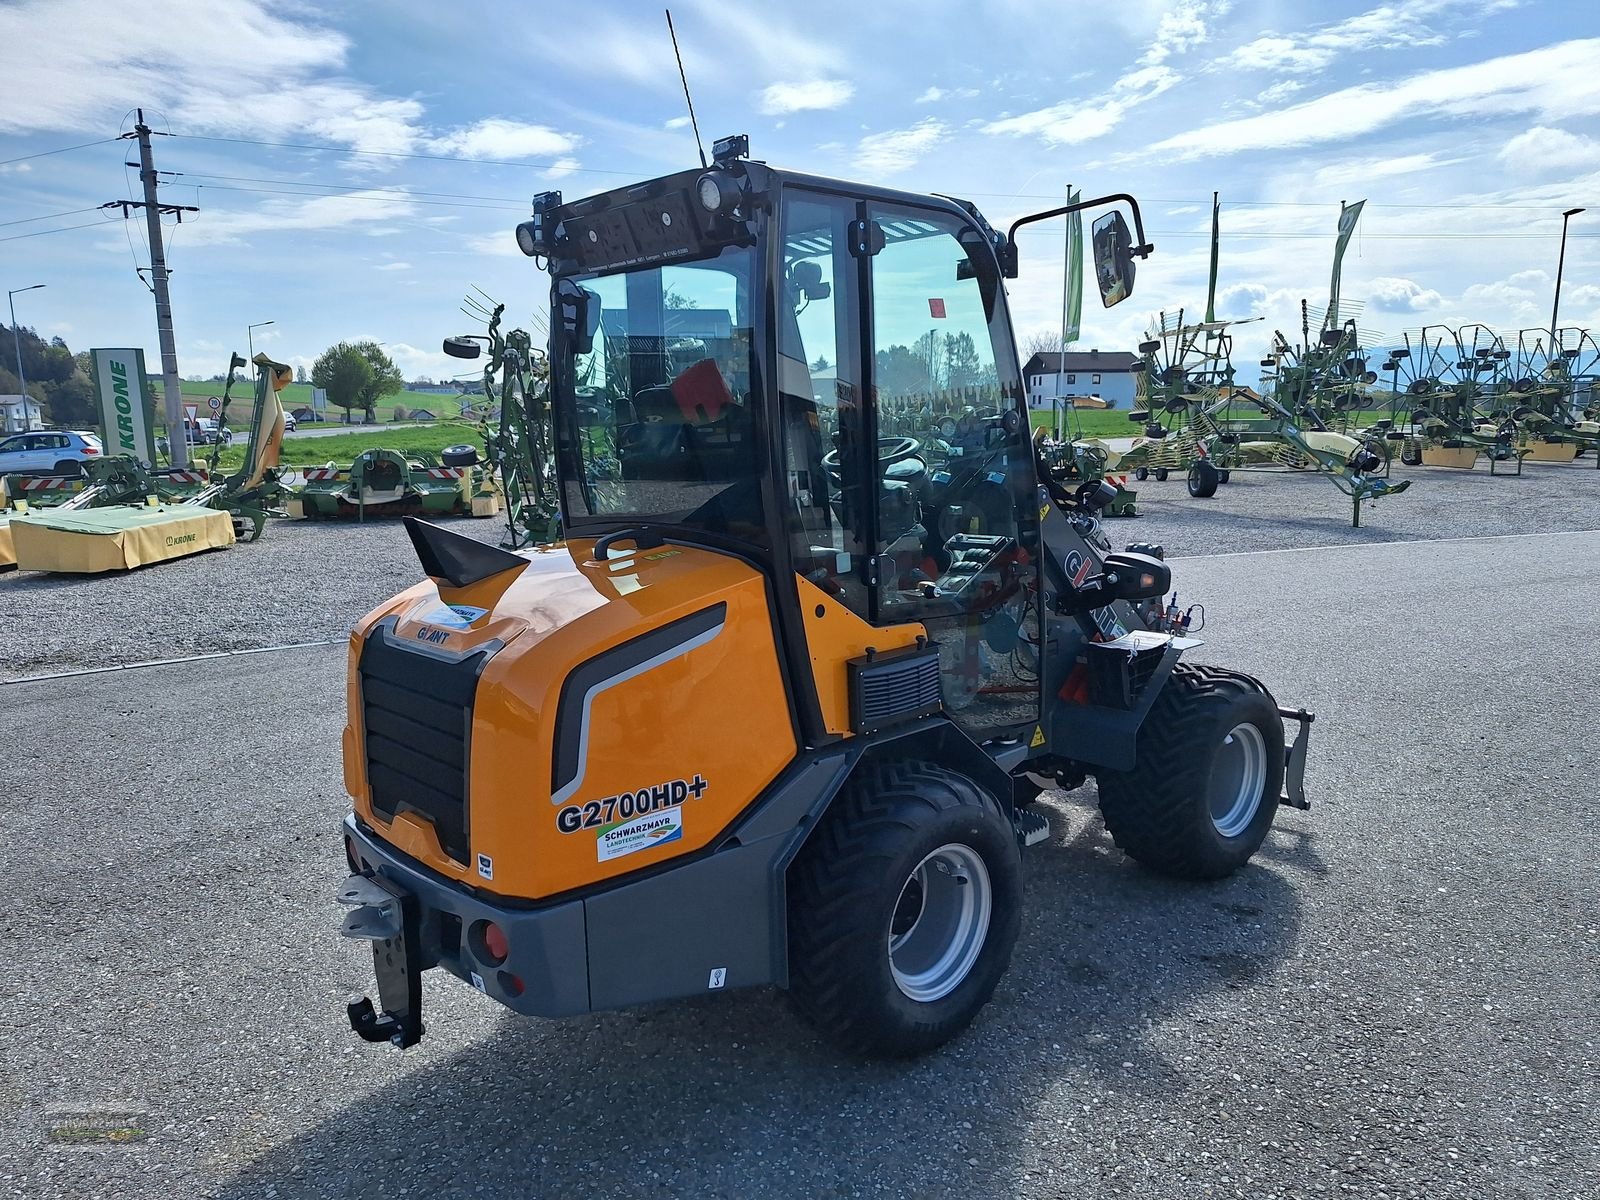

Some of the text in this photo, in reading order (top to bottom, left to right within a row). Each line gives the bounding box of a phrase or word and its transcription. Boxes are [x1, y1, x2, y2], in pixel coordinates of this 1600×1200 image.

[109, 360, 136, 451] KRONE
[173, 533, 196, 545] KRONE
[417, 625, 450, 645] GIANT
[556, 774, 708, 835] G2700HD+
[604, 817, 671, 842] SCHWARZMAYR
[606, 832, 647, 848] LANDTECHNIK
